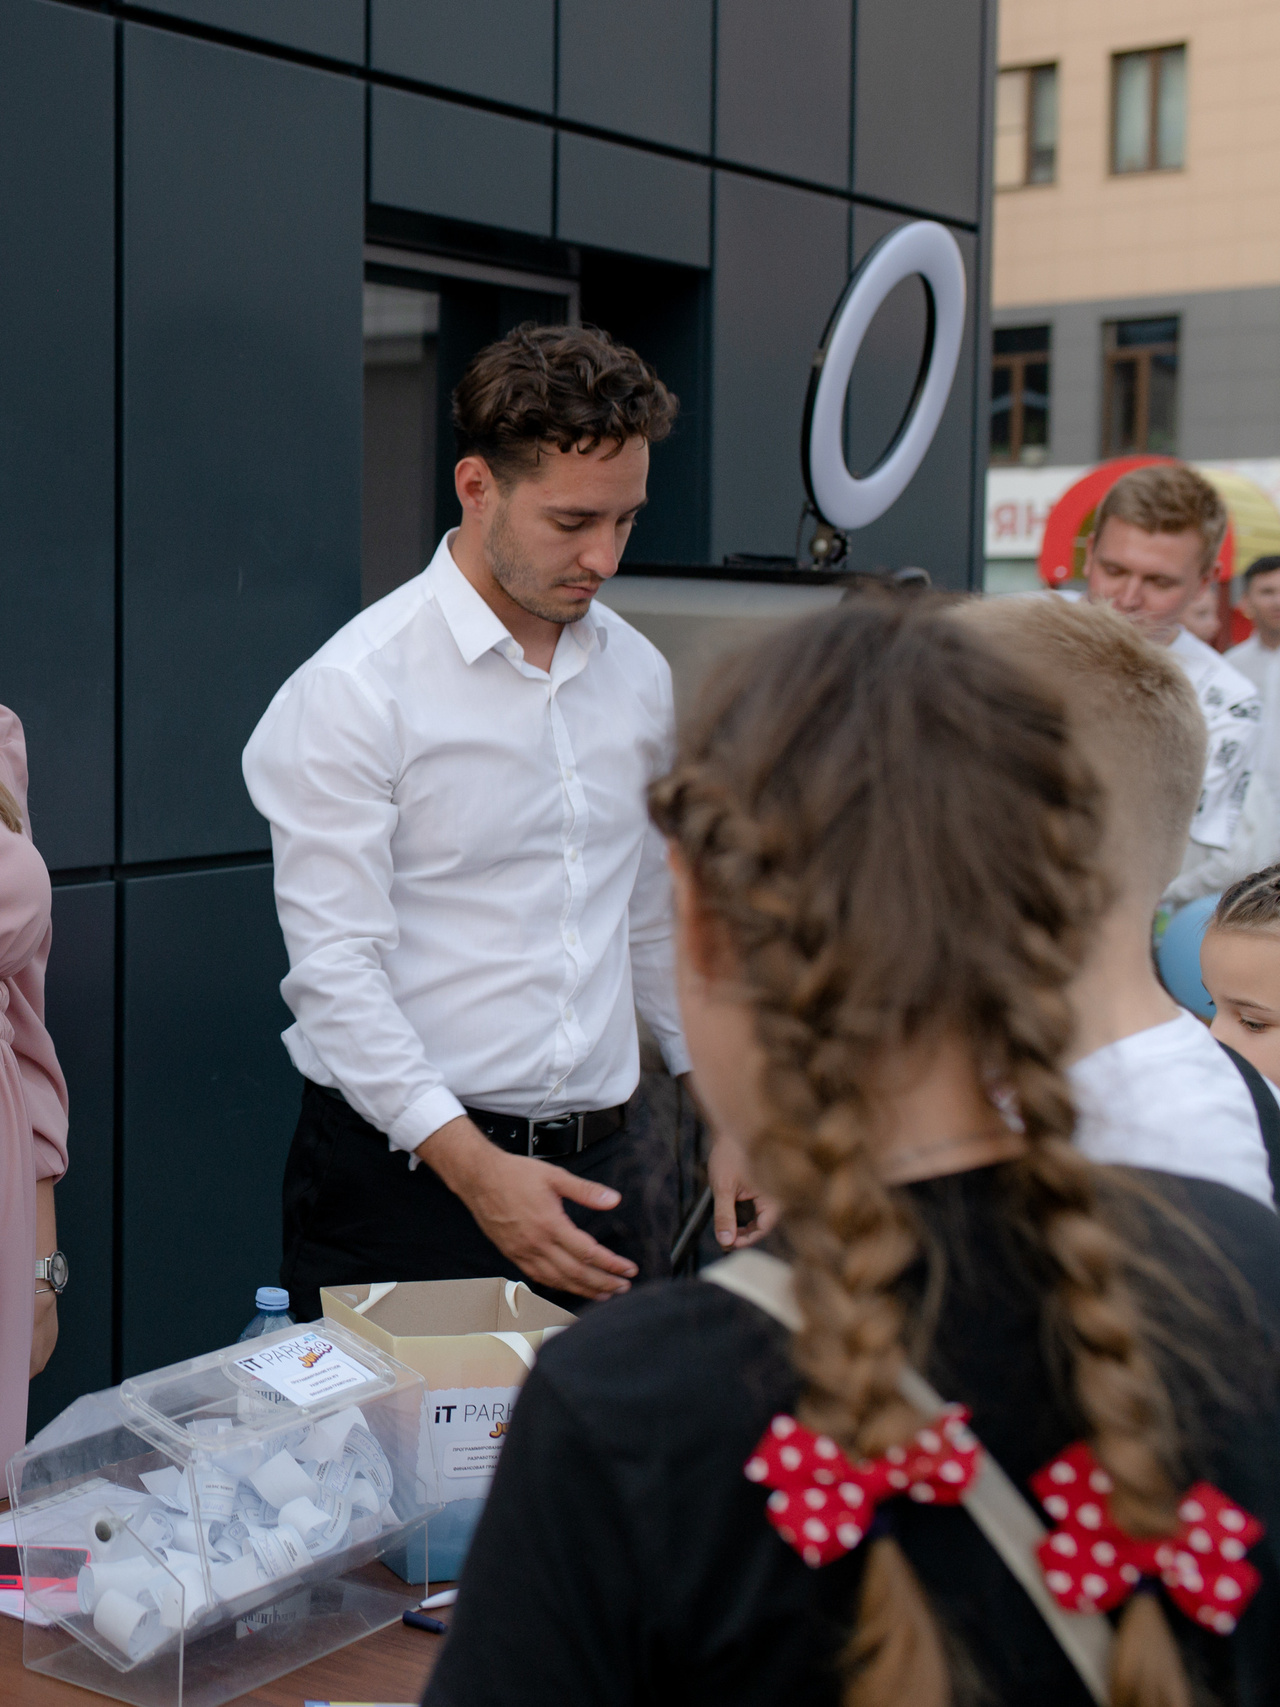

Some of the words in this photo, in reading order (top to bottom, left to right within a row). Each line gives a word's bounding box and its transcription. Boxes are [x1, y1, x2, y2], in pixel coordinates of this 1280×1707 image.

[239, 1357, 263, 1371] iT
[259, 1341, 306, 1366] PARK
[435, 1405, 457, 1423] iT
